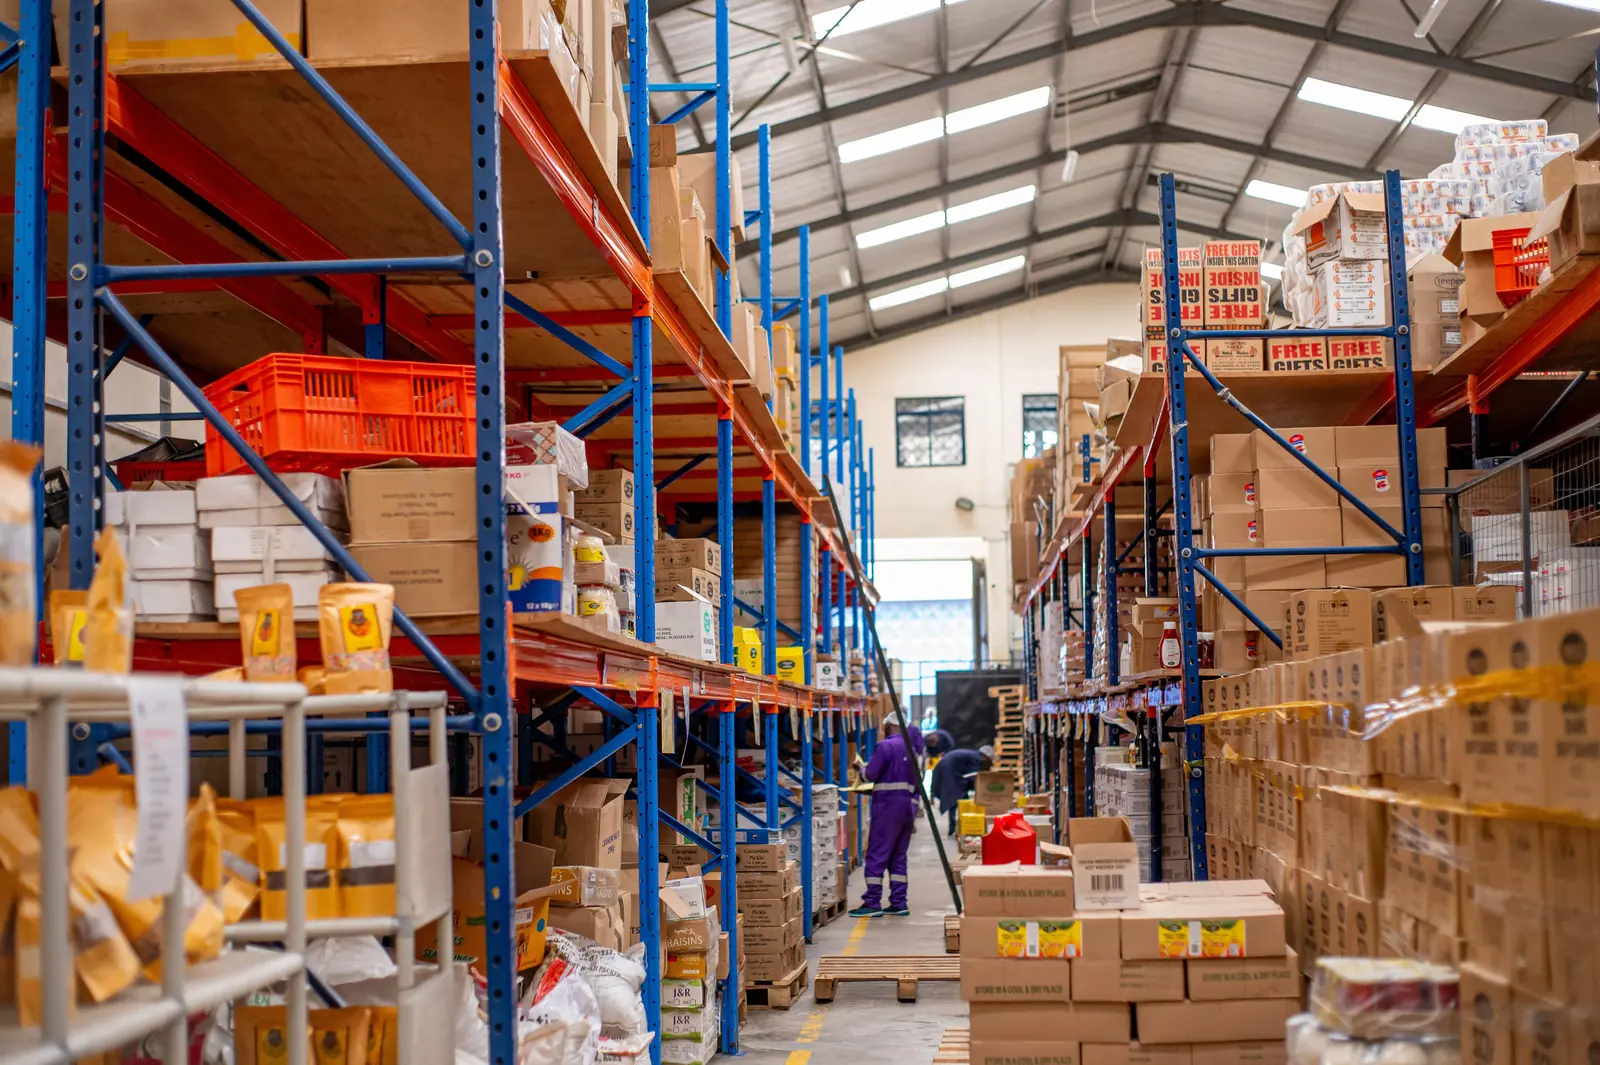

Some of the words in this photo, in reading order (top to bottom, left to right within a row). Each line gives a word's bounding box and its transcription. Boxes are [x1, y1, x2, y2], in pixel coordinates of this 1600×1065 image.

[1178, 250, 1200, 260] IFTS
[1206, 243, 1229, 256] FREE
[1231, 243, 1259, 256] GIFTS
[1206, 256, 1225, 266] INSIDE
[1225, 256, 1238, 265] THIS
[1238, 256, 1259, 266] CARTON
[1209, 271, 1259, 286] INSIDE
[1208, 287, 1259, 303] GIFTS
[1209, 304, 1260, 319] FREE
[1272, 342, 1323, 359] FREE
[1331, 340, 1381, 357] FREE
[1047, 889, 1067, 898] PLACE
[667, 935, 703, 948] RAISINS
[673, 988, 691, 998] J&R
[1043, 985, 1063, 994] PLACE
[673, 1015, 690, 1026] J&R
